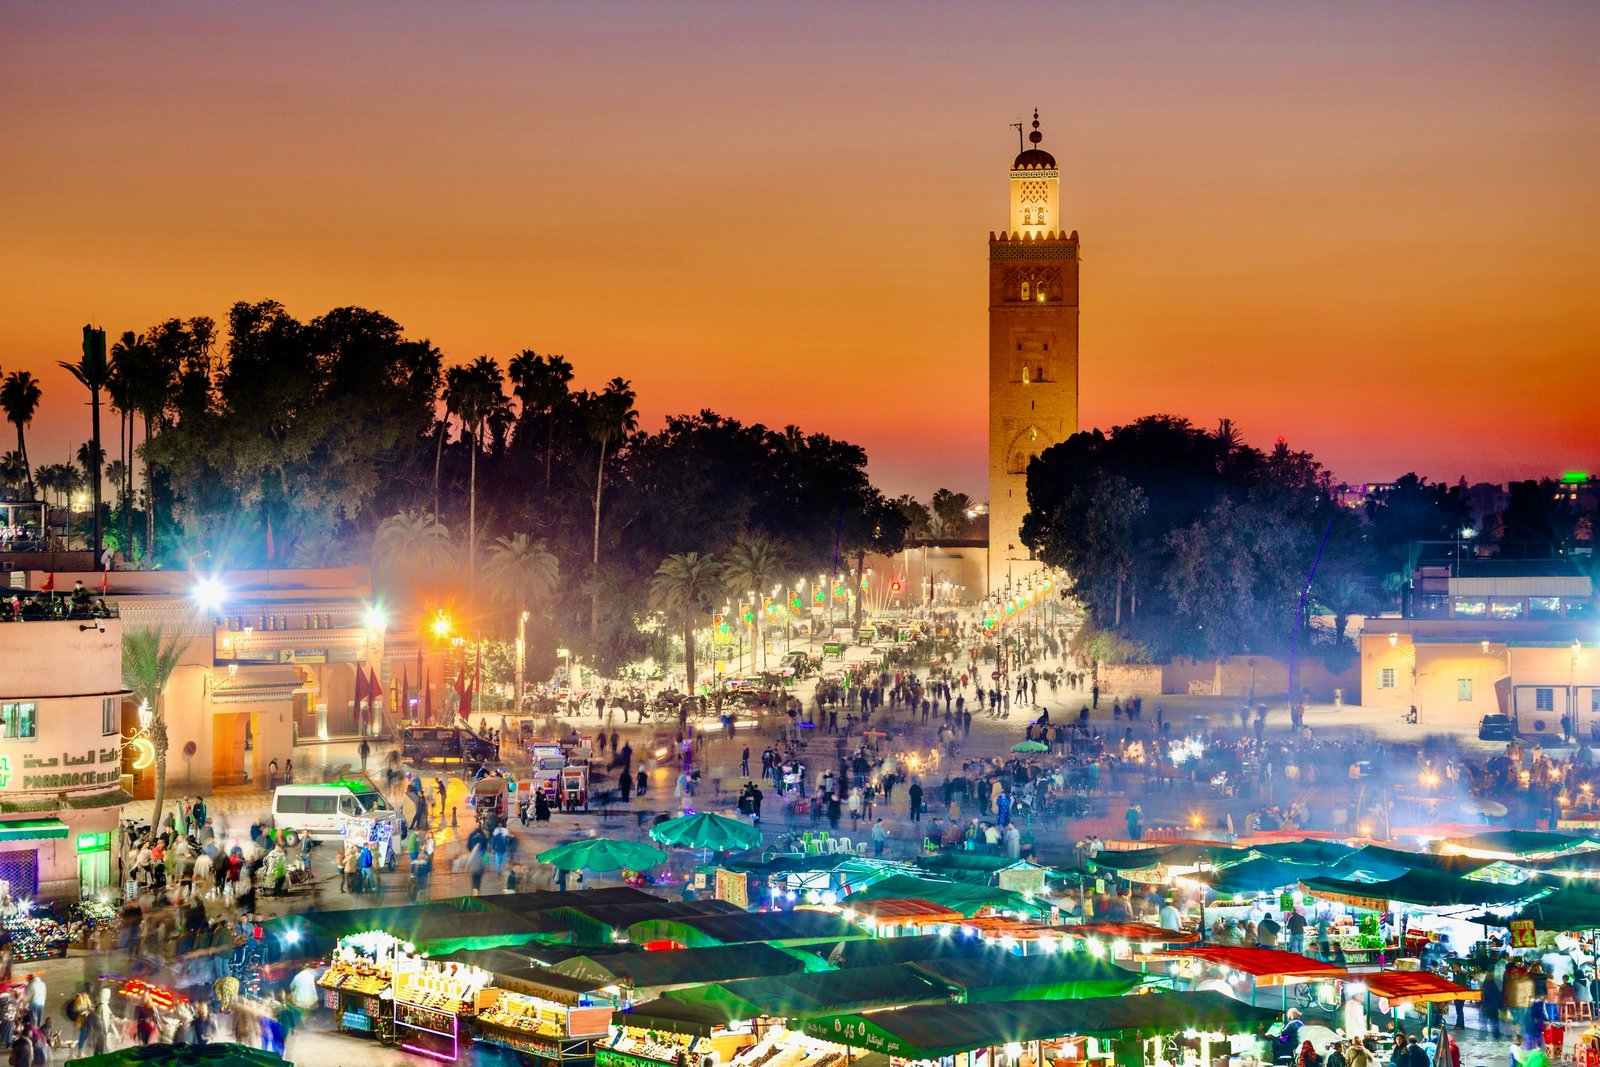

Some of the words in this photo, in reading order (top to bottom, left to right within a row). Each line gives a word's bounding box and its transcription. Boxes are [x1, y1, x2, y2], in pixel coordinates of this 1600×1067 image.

[23, 771, 96, 788] PHARMACIE
[1512, 930, 1535, 947] 14
[1184, 960, 1191, 969] 2
[843, 1023, 855, 1039] 45
